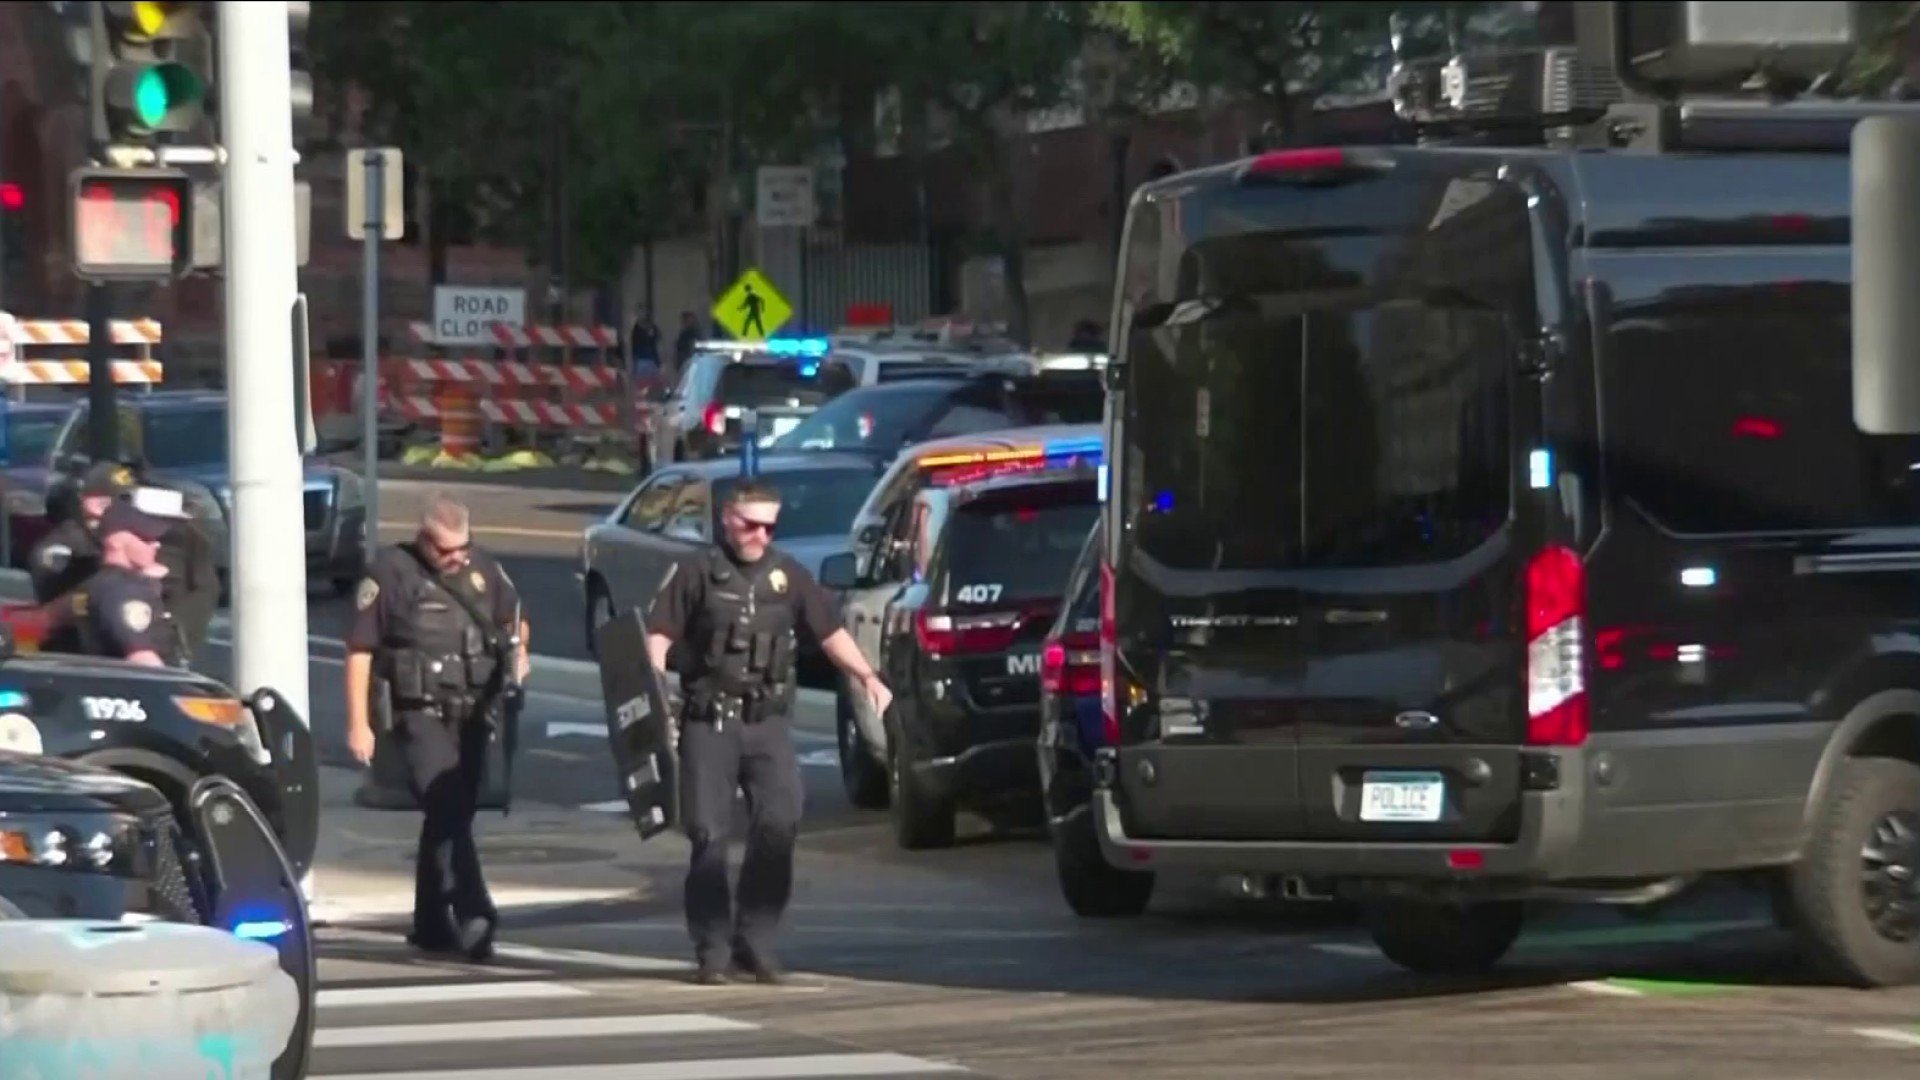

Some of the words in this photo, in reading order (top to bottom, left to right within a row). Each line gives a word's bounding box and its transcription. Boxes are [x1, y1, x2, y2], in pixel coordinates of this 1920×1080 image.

[454, 295, 509, 314] ROAD
[957, 585, 1003, 603] 407
[1372, 786, 1429, 810] POLICE
